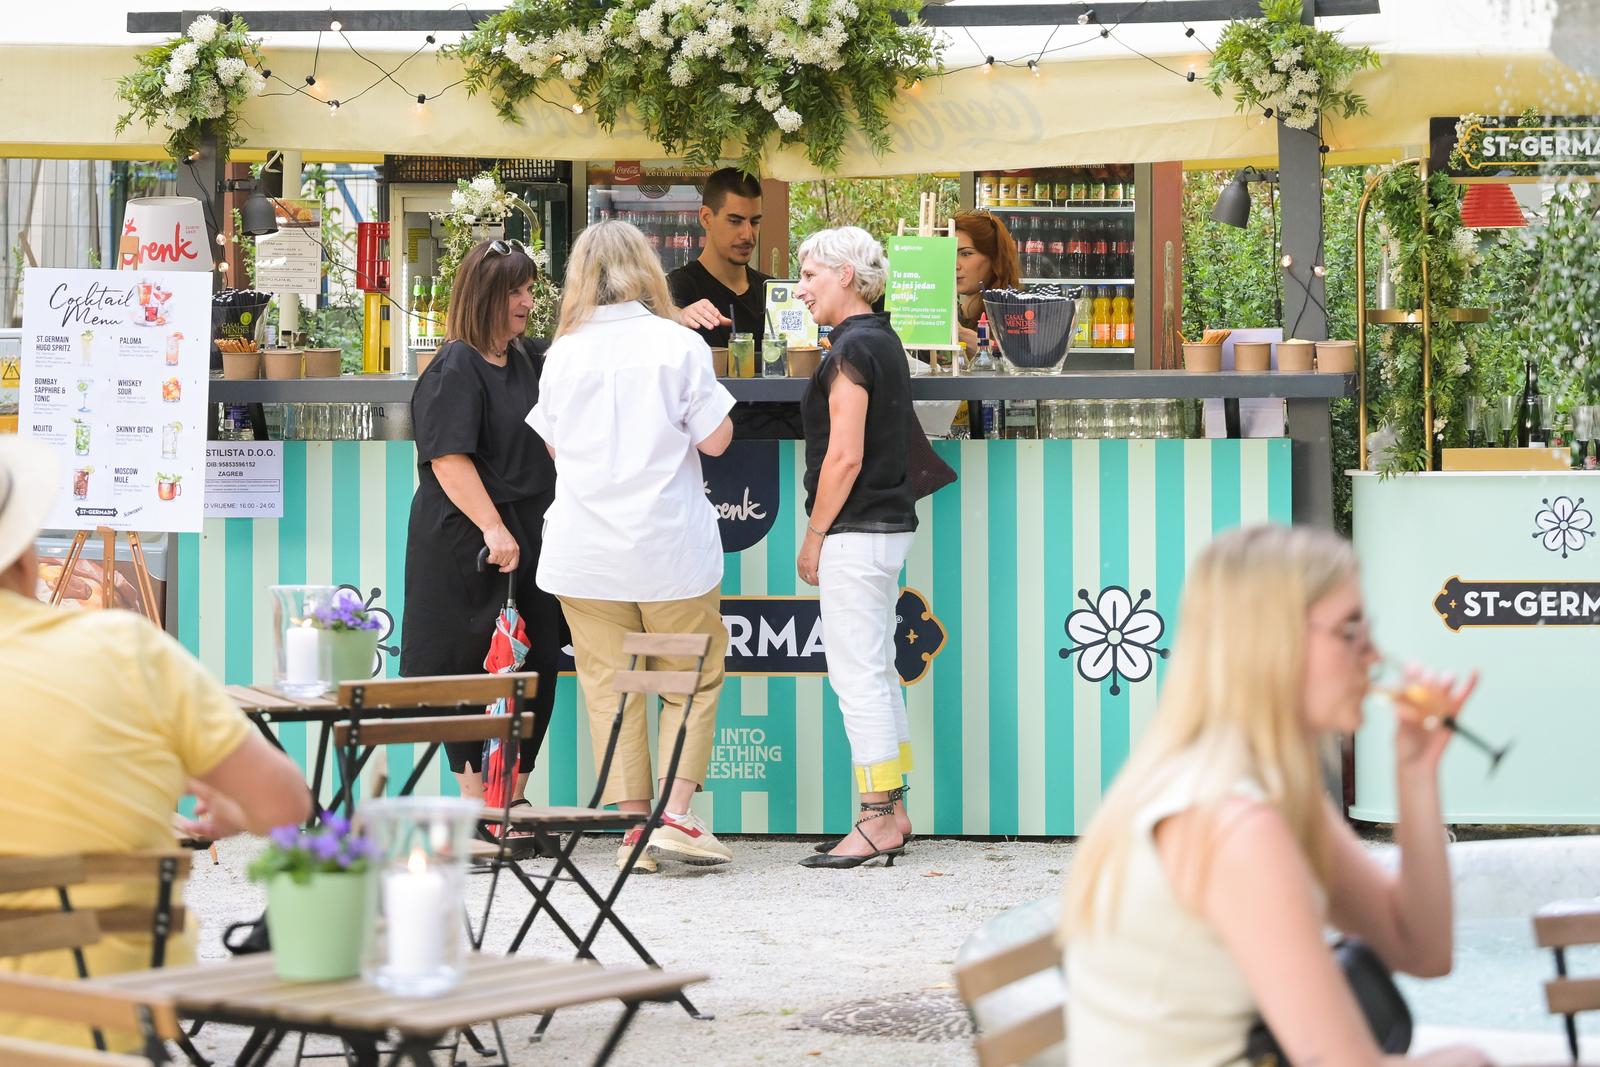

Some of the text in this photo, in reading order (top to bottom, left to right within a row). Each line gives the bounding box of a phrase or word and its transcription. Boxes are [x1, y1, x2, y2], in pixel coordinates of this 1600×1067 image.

[892, 270, 902, 279] Tu
[891, 281, 901, 289] Za
[914, 281, 935, 290] jedan
[49, 281, 135, 310] Cocktail
[62, 304, 123, 327] Menu
[52, 344, 71, 352] SPRITZ
[34, 377, 57, 385] BOMBAY
[117, 379, 142, 387] WHISKEY
[34, 386, 60, 394] SAPPHIRE
[32, 424, 53, 432] MOJITO
[115, 425, 153, 434] SKINNY BITCH
[247, 448, 276, 457] D.O.O.
[114, 467, 138, 475] MOSCOW
[721, 728, 766, 745] INTO
